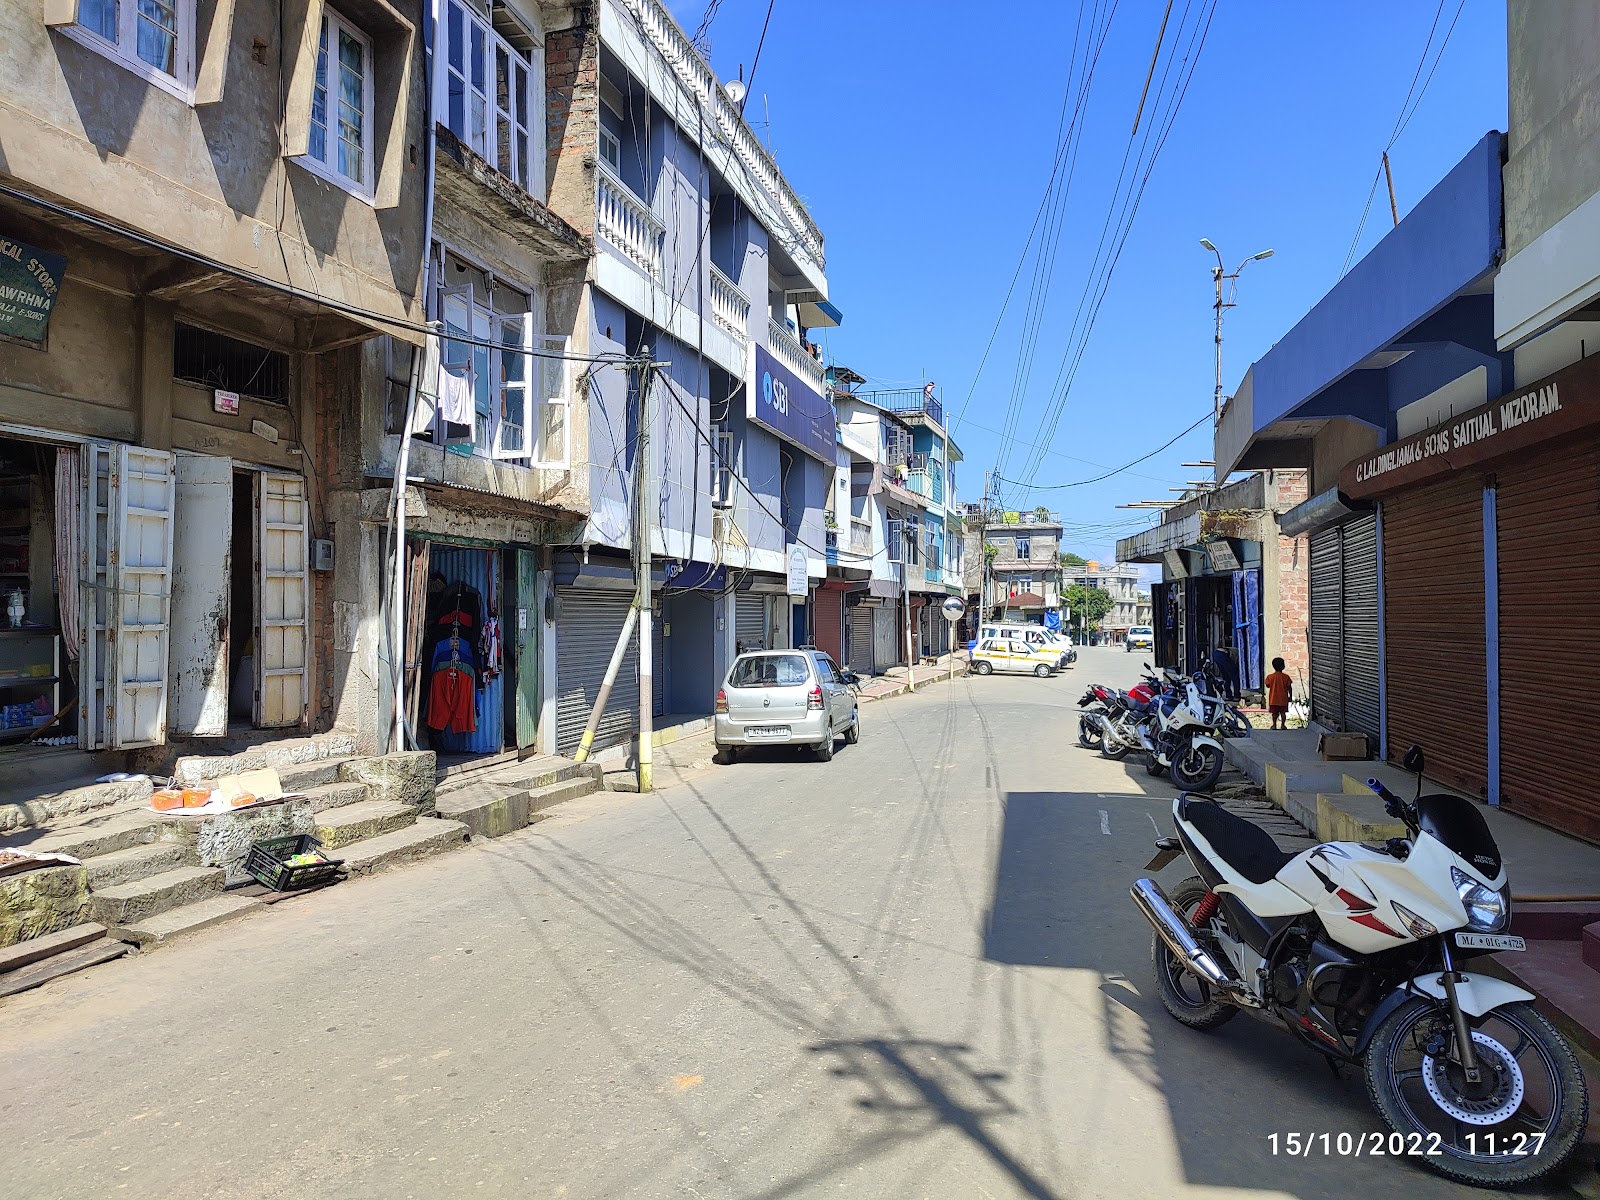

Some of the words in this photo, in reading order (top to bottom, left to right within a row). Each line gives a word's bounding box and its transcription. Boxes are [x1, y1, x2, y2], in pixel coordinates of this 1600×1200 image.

[27, 258, 57, 297] STORE
[25, 310, 45, 321] SONS
[773, 377, 789, 417] SBI
[1415, 440, 1423, 462] &
[1424, 429, 1450, 458] SONS
[1452, 410, 1498, 449] SAITUAL
[1500, 382, 1562, 431] MIZORAM.
